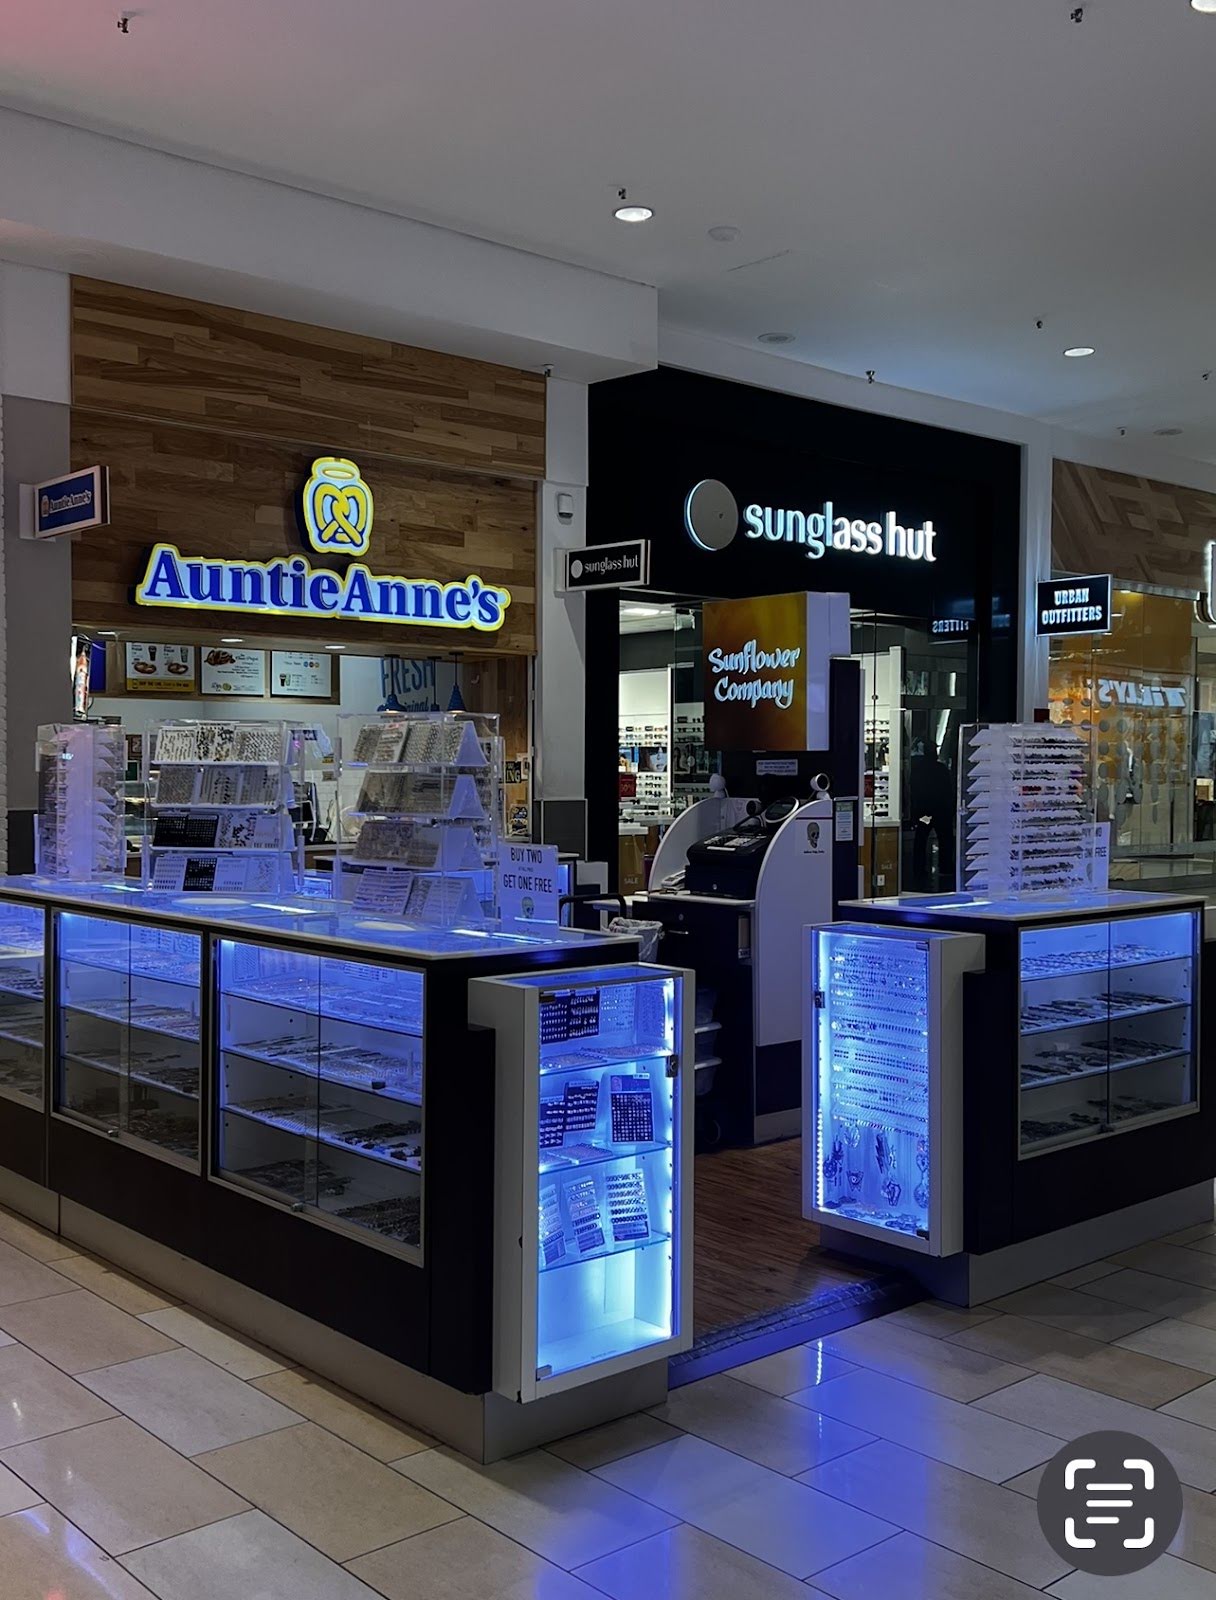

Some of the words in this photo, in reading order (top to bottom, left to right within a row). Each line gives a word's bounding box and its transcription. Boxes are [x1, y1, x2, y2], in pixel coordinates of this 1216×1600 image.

[743, 501, 883, 559] sunglass
[886, 511, 937, 562] hut
[584, 557, 622, 575] sunglass
[623, 555, 638, 568] hut
[1054, 588, 1089, 605] URBAN
[1042, 606, 1102, 625] OUTFITTERS
[708, 639, 800, 675] Sunflower
[714, 676, 794, 709] Company
[510, 847, 524, 863] BUY
[526, 849, 543, 864] TWO
[503, 874, 517, 889] GET
[518, 876, 533, 891] ONE
[534, 878, 552, 893] FREE
